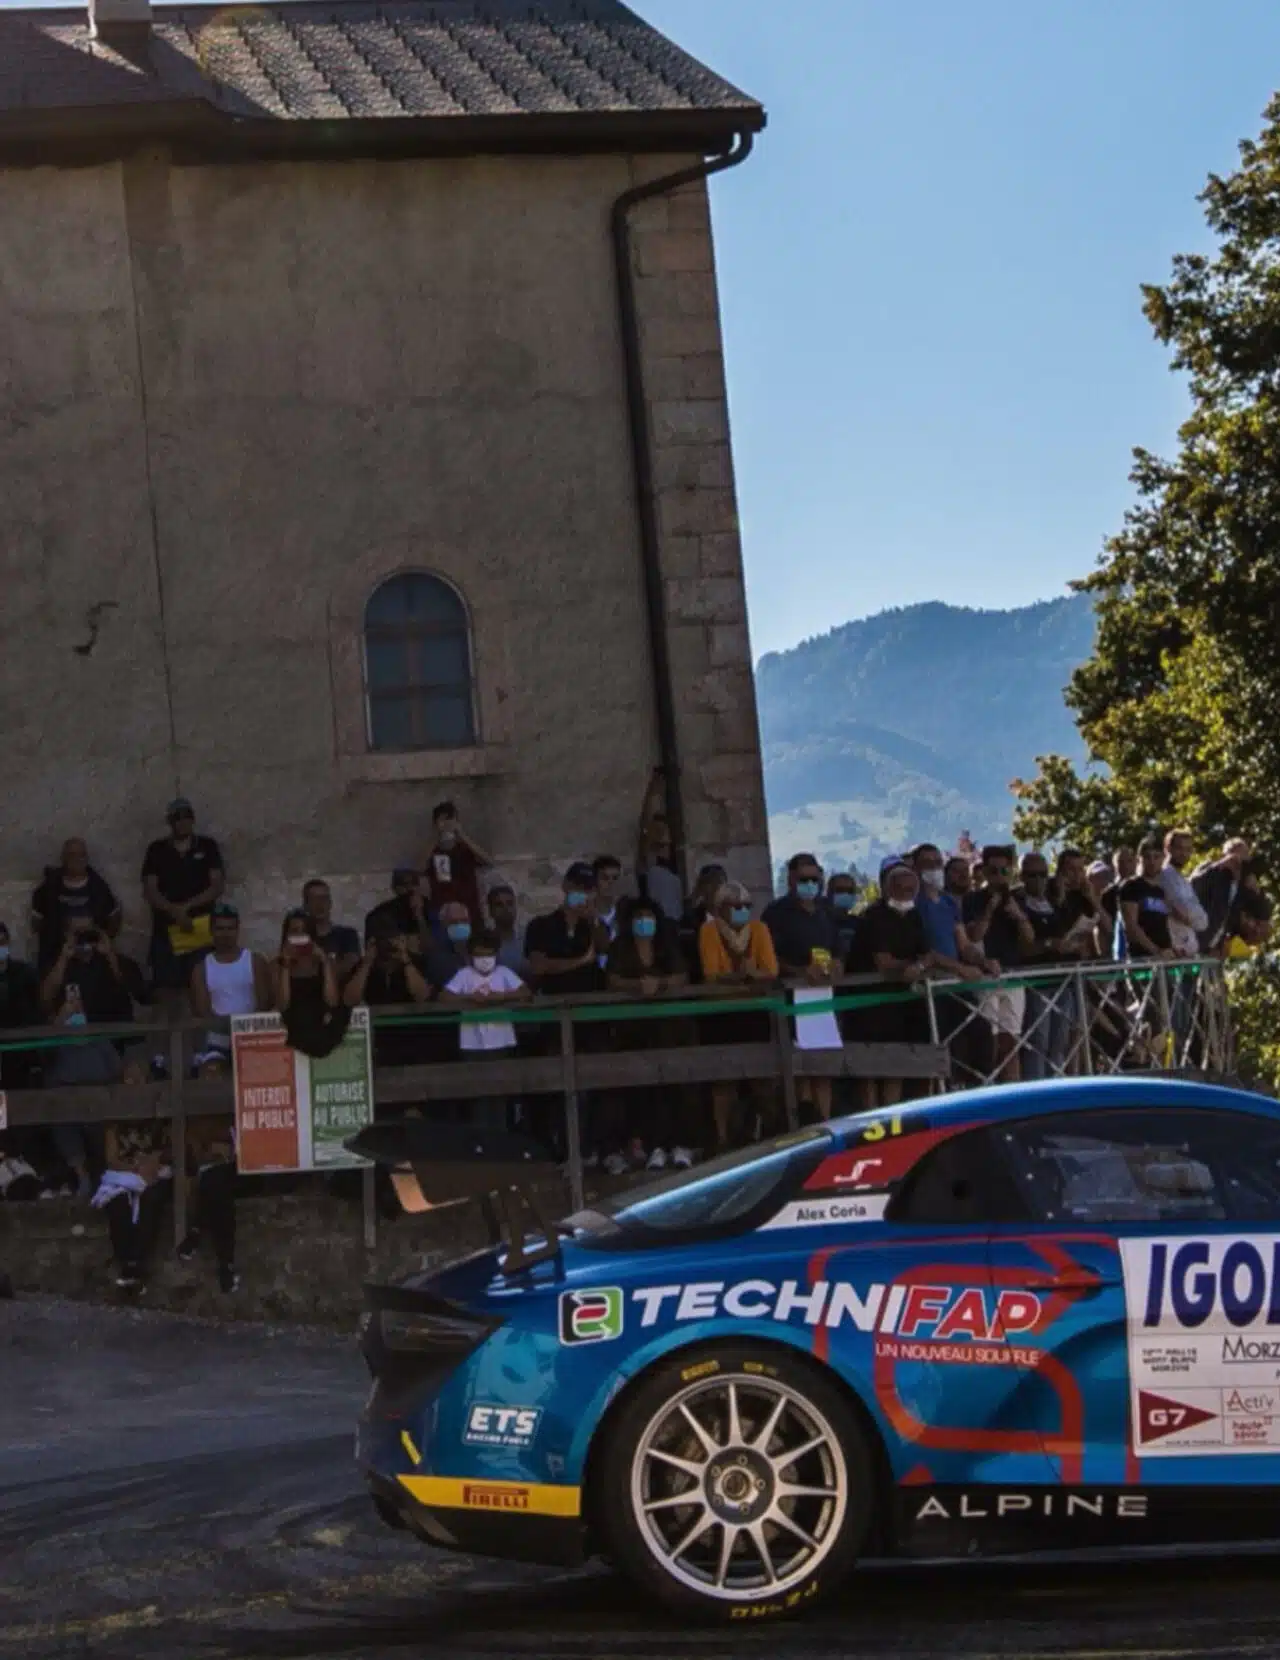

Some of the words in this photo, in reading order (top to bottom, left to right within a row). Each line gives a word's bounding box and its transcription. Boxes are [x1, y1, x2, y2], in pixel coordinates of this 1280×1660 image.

[243, 1086, 292, 1107] INTERDIT
[241, 1110, 257, 1130] AU
[258, 1108, 297, 1129] PUBLIC
[313, 1105, 329, 1128] AU
[330, 1103, 369, 1128] PUBLIC
[796, 1207, 826, 1221] Alex
[829, 1204, 867, 1218] Coria
[876, 1343, 899, 1358] UN
[901, 1345, 973, 1361] NOUVEAU
[470, 1407, 538, 1435] ETS
[1148, 1408, 1188, 1427] G7
[462, 1484, 530, 1510] PIRELLI
[915, 1494, 1149, 1520] ALPINE
